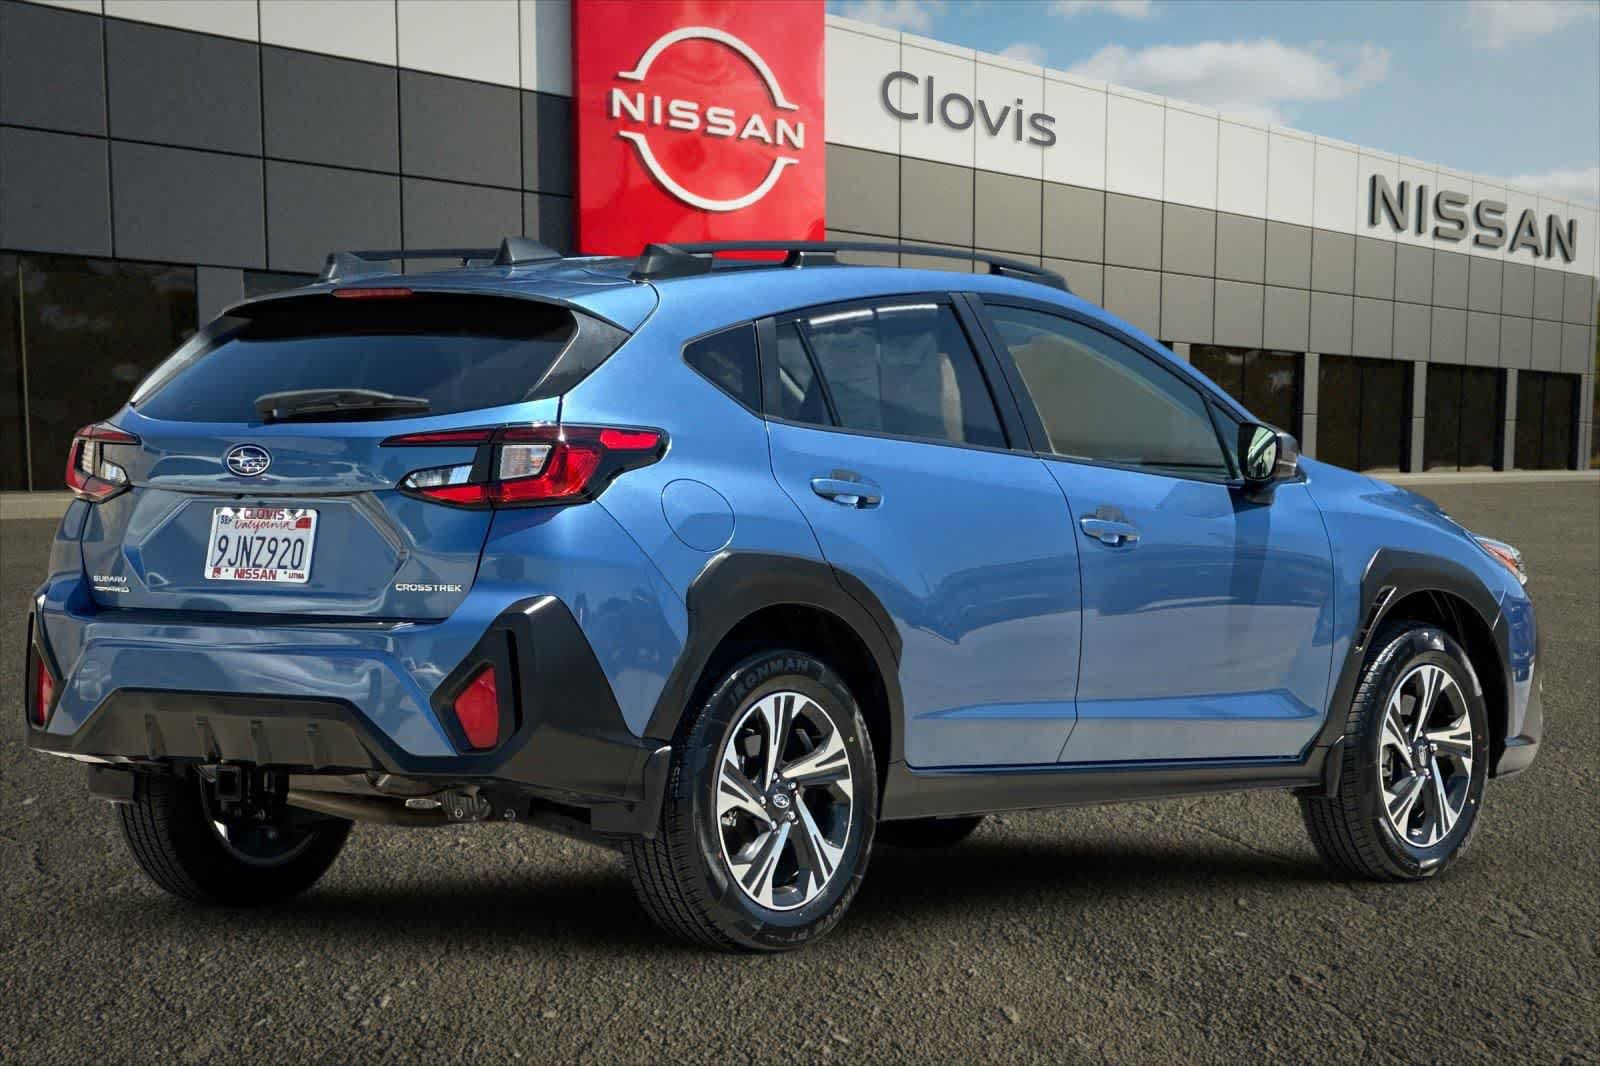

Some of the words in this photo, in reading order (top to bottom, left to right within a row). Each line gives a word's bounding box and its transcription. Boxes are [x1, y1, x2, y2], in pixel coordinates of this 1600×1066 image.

[611, 88, 805, 149] NISSAN
[881, 71, 1057, 147] Clovis
[1368, 174, 1577, 263] NISSAN
[244, 508, 285, 520] CLOVIS
[215, 535, 304, 569] 9JNZ920
[234, 569, 277, 580] NISSAN
[395, 583, 463, 592] CROSSTREK
